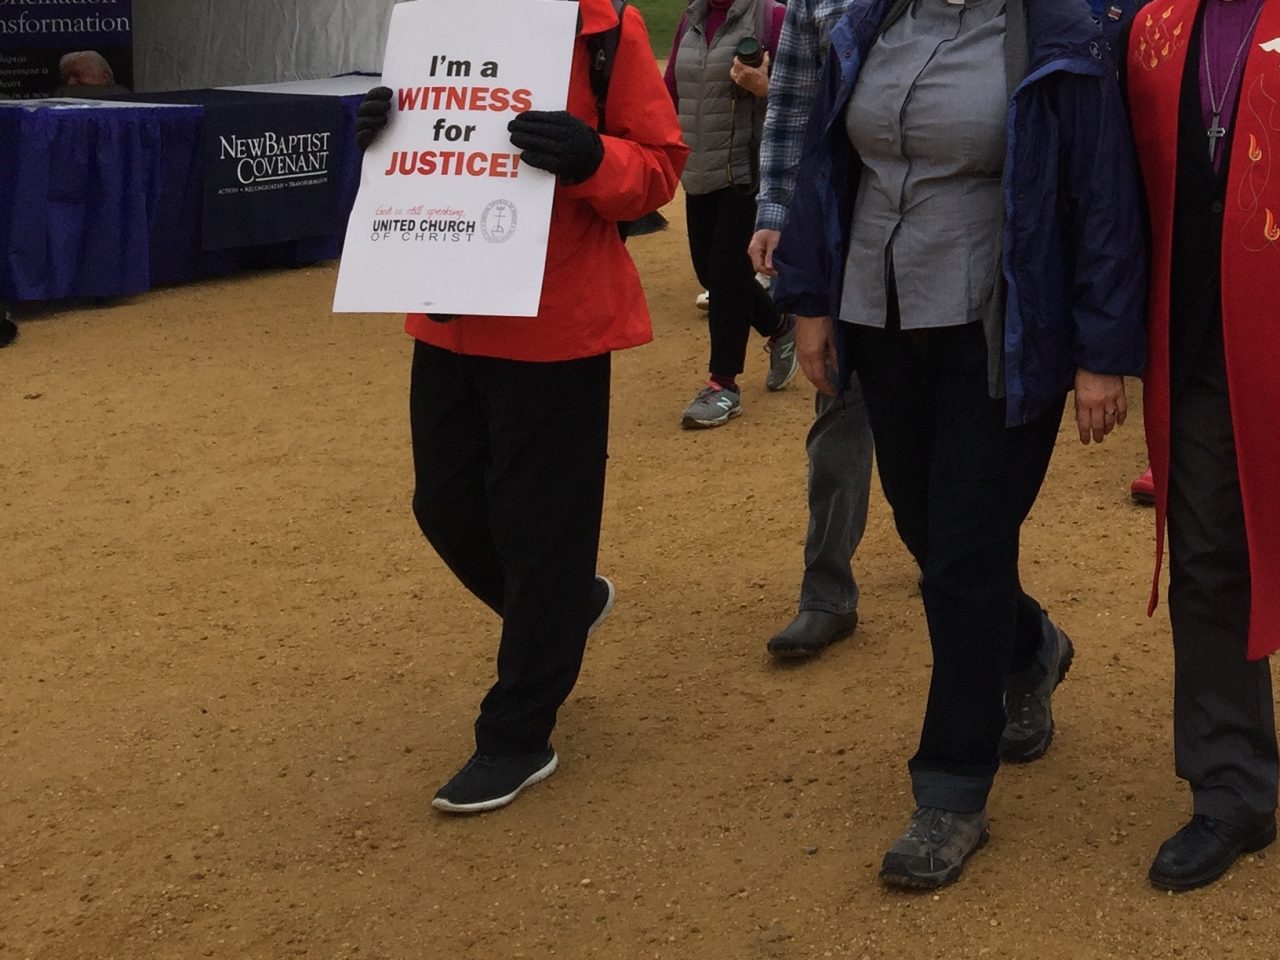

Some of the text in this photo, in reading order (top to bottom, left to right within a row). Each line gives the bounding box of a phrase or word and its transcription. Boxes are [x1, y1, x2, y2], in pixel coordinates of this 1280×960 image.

[429, 55, 499, 78] I'm a
[397, 86, 533, 113] WITNESS
[432, 118, 476, 142] for
[237, 152, 329, 184] COVENANT
[384, 150, 521, 178] JUSTICE!
[371, 232, 475, 242] OF CHRIST
[372, 219, 476, 233] UNITED CHURCH
